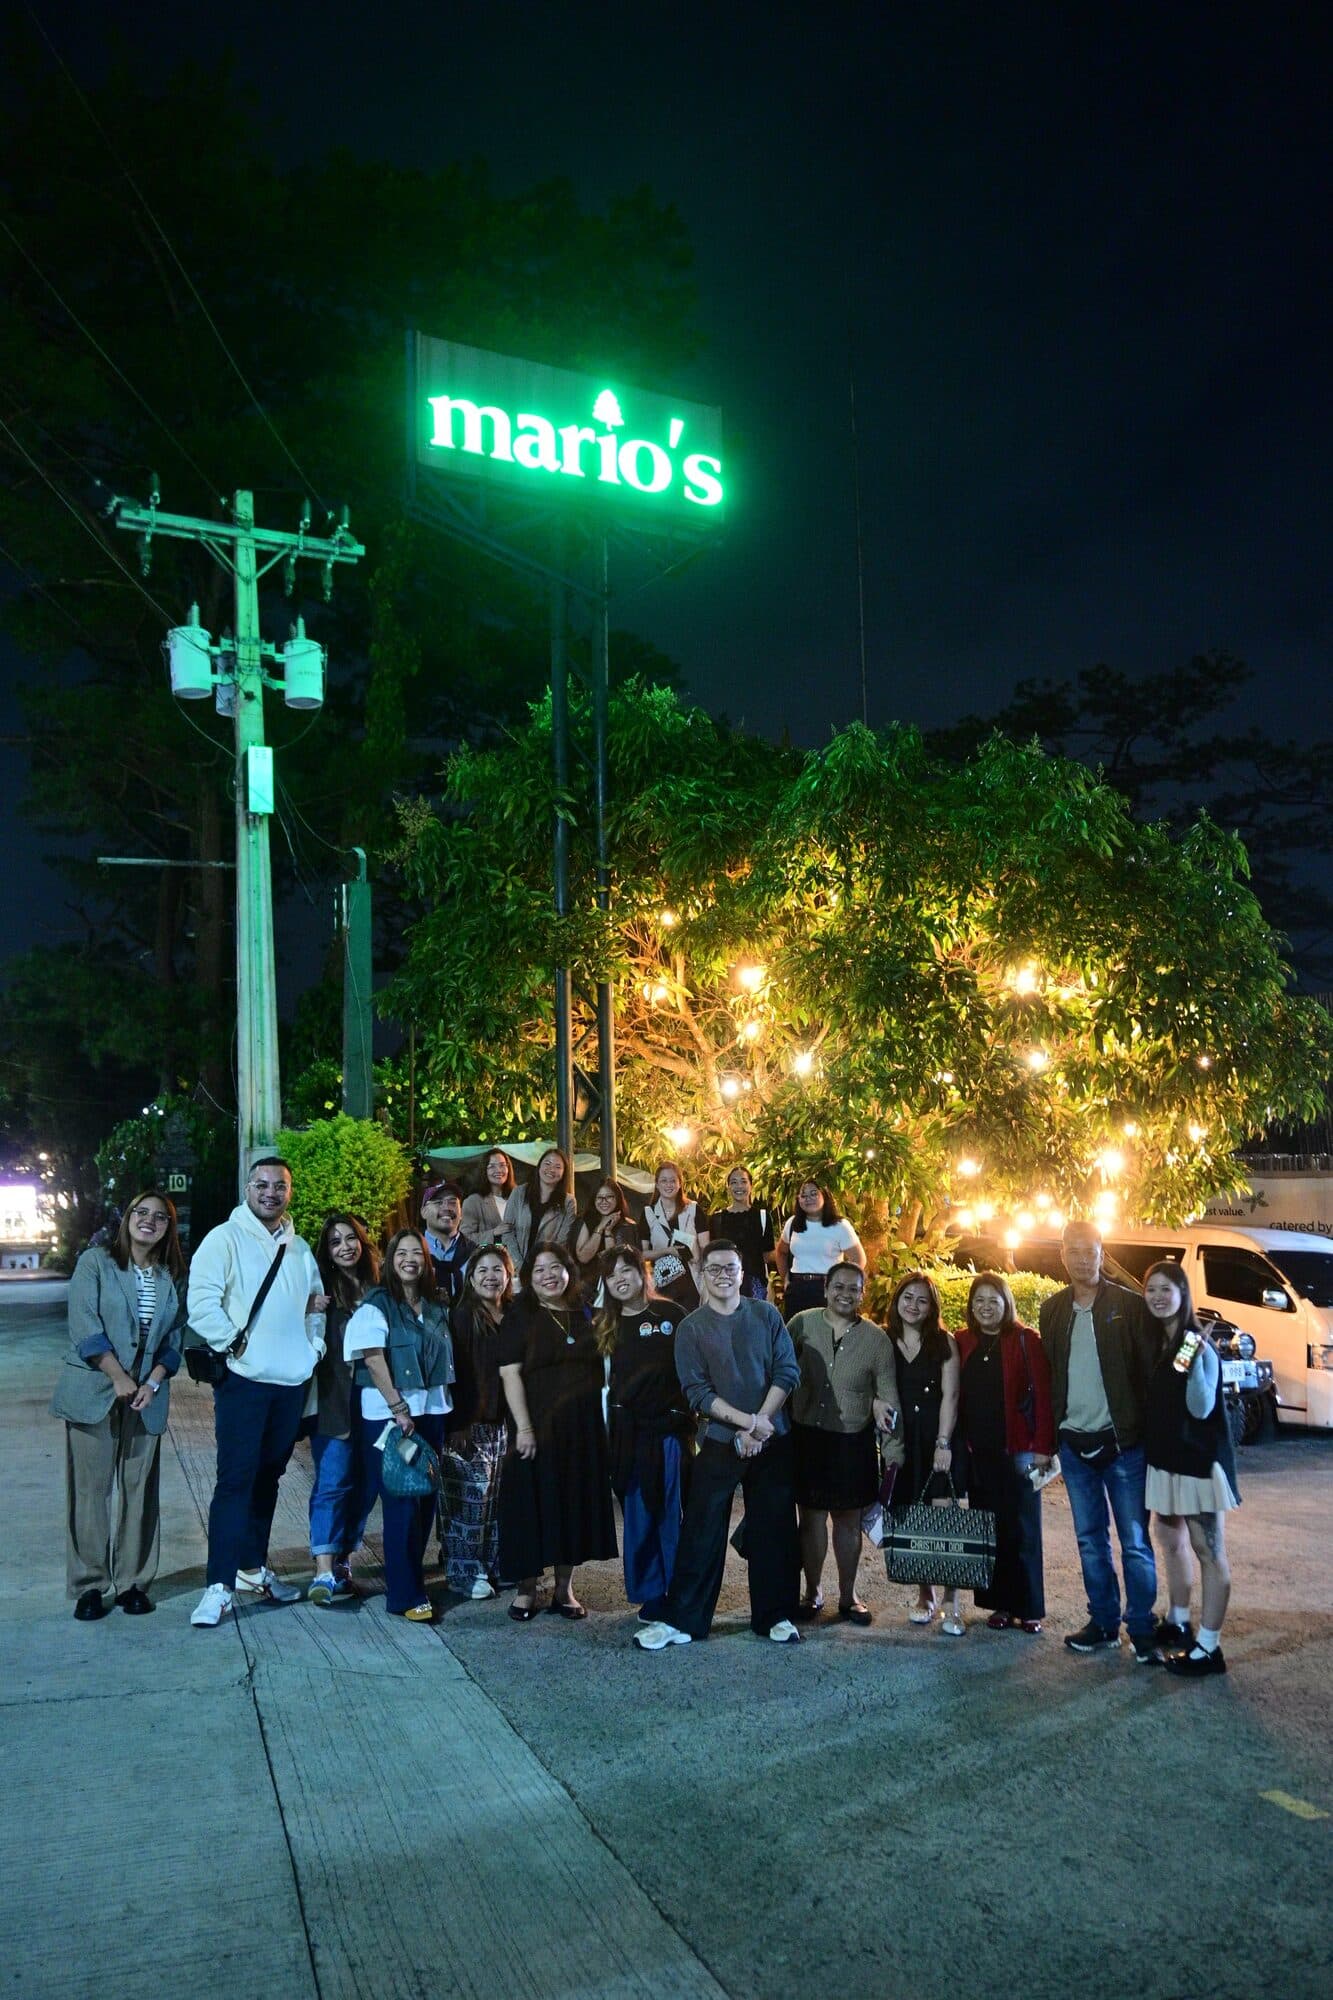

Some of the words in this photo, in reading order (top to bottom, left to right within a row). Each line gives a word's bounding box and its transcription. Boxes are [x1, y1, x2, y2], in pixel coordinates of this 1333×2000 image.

[428, 390, 723, 505] mario's
[171, 1176, 185, 1190] 10
[1204, 1207, 1216, 1216] est
[1218, 1207, 1245, 1216] value.
[1269, 1221, 1315, 1232] catered
[1317, 1220, 1333, 1234] by
[911, 1540, 946, 1552] CHRISTIAN
[949, 1542, 964, 1553] DIOR
